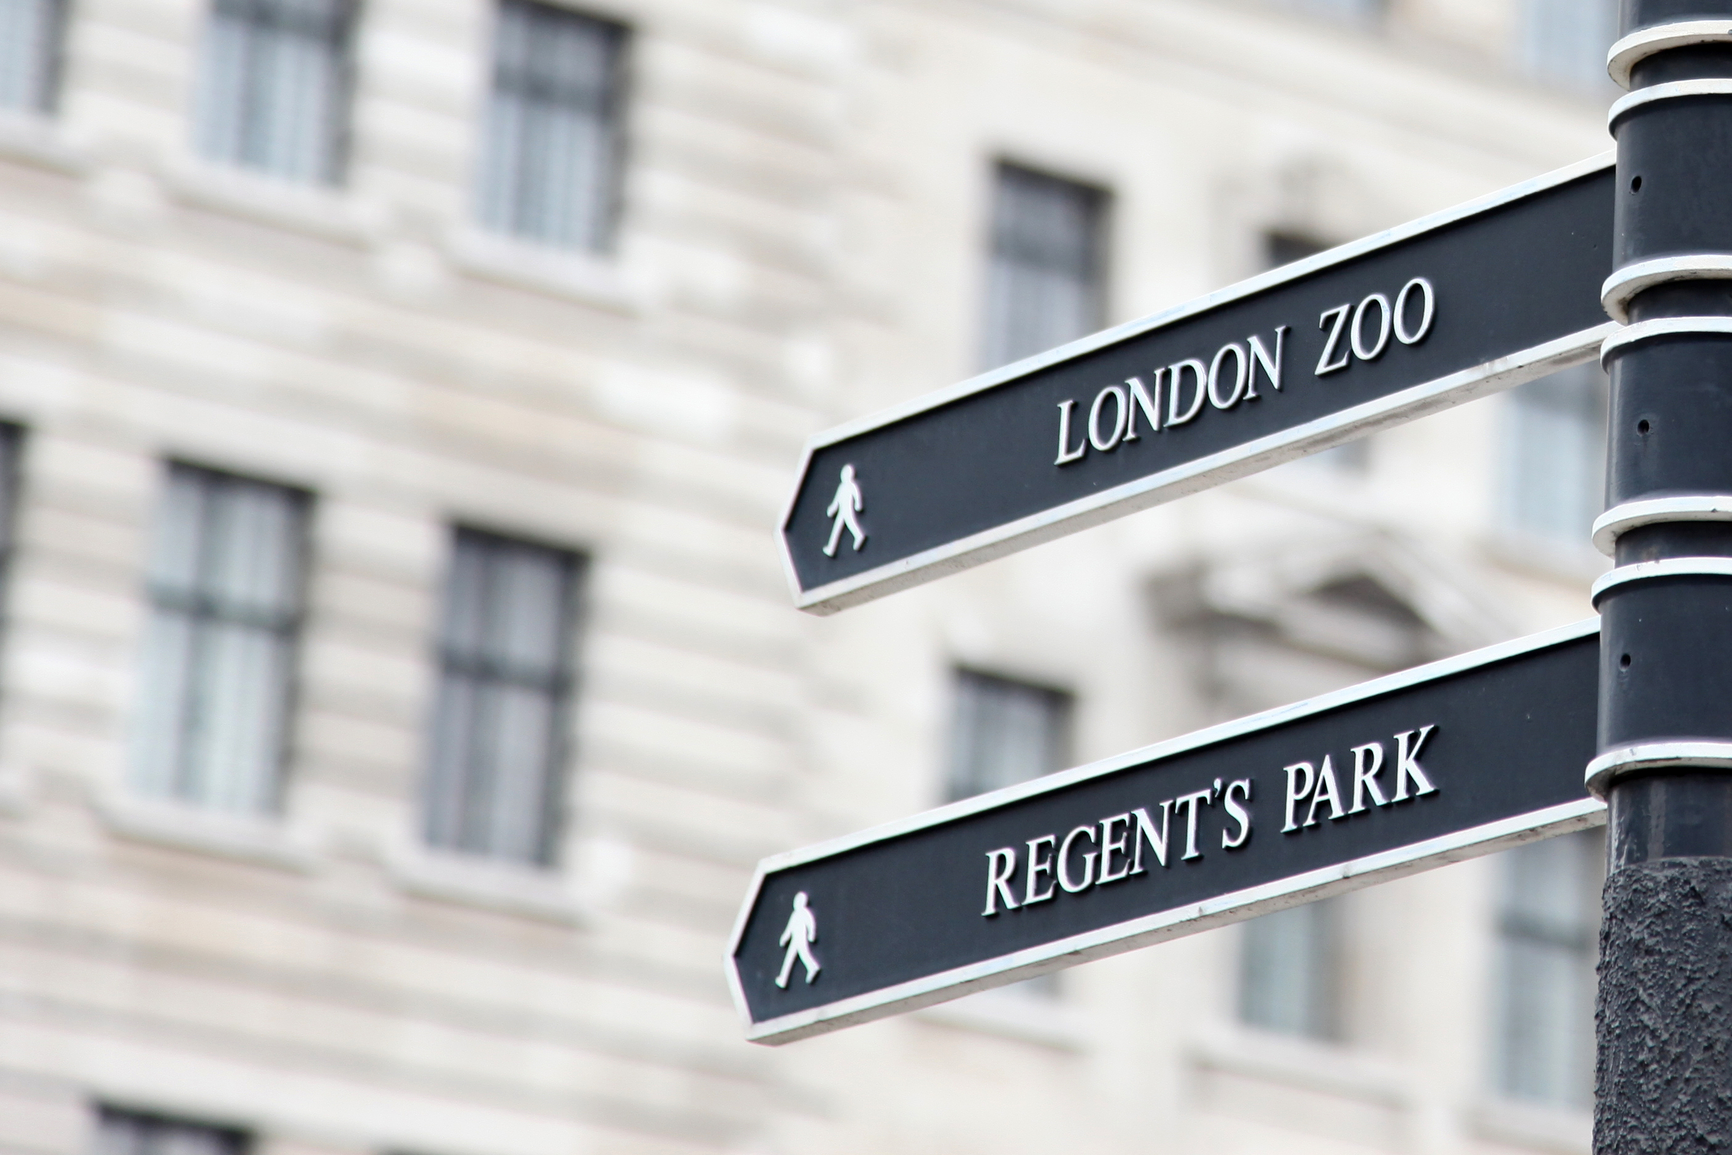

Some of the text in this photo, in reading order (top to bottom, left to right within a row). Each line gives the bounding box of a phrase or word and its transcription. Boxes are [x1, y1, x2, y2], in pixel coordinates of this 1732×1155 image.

[1054, 277, 1435, 466] LONDON ZOO
[981, 724, 1437, 916] REGENT'S PARK
